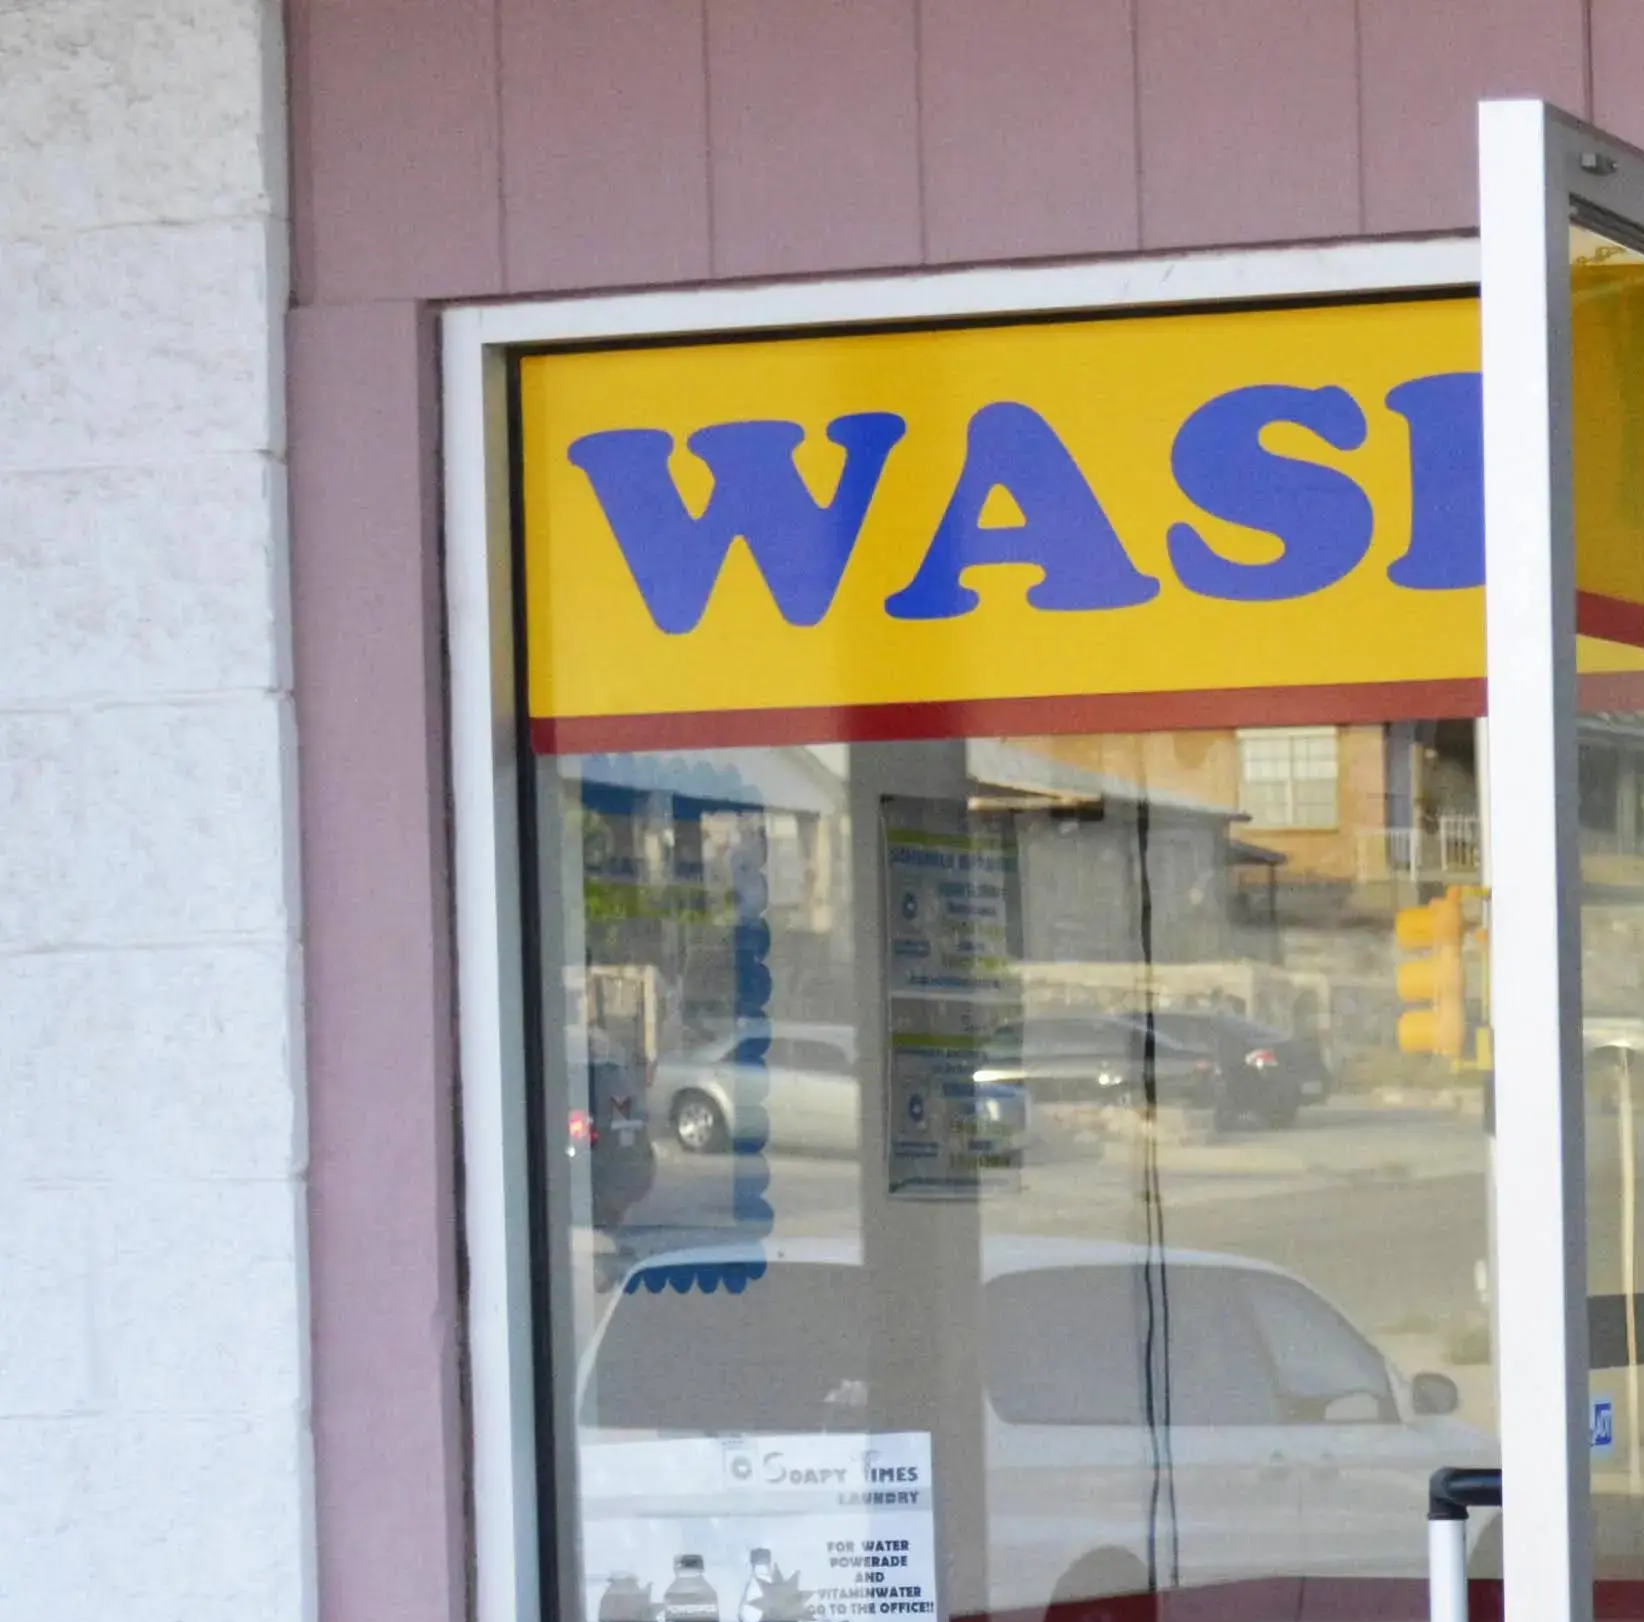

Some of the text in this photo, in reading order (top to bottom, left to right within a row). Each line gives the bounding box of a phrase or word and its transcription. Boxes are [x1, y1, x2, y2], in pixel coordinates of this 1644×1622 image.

[826, 1540, 910, 1552] FOR WATER
[830, 1556, 908, 1568] POWERADE
[855, 1572, 885, 1583] AND
[818, 1586, 921, 1599] VITAMINWATER
[807, 1602, 934, 1615] GO TO THE OFFICE!!
